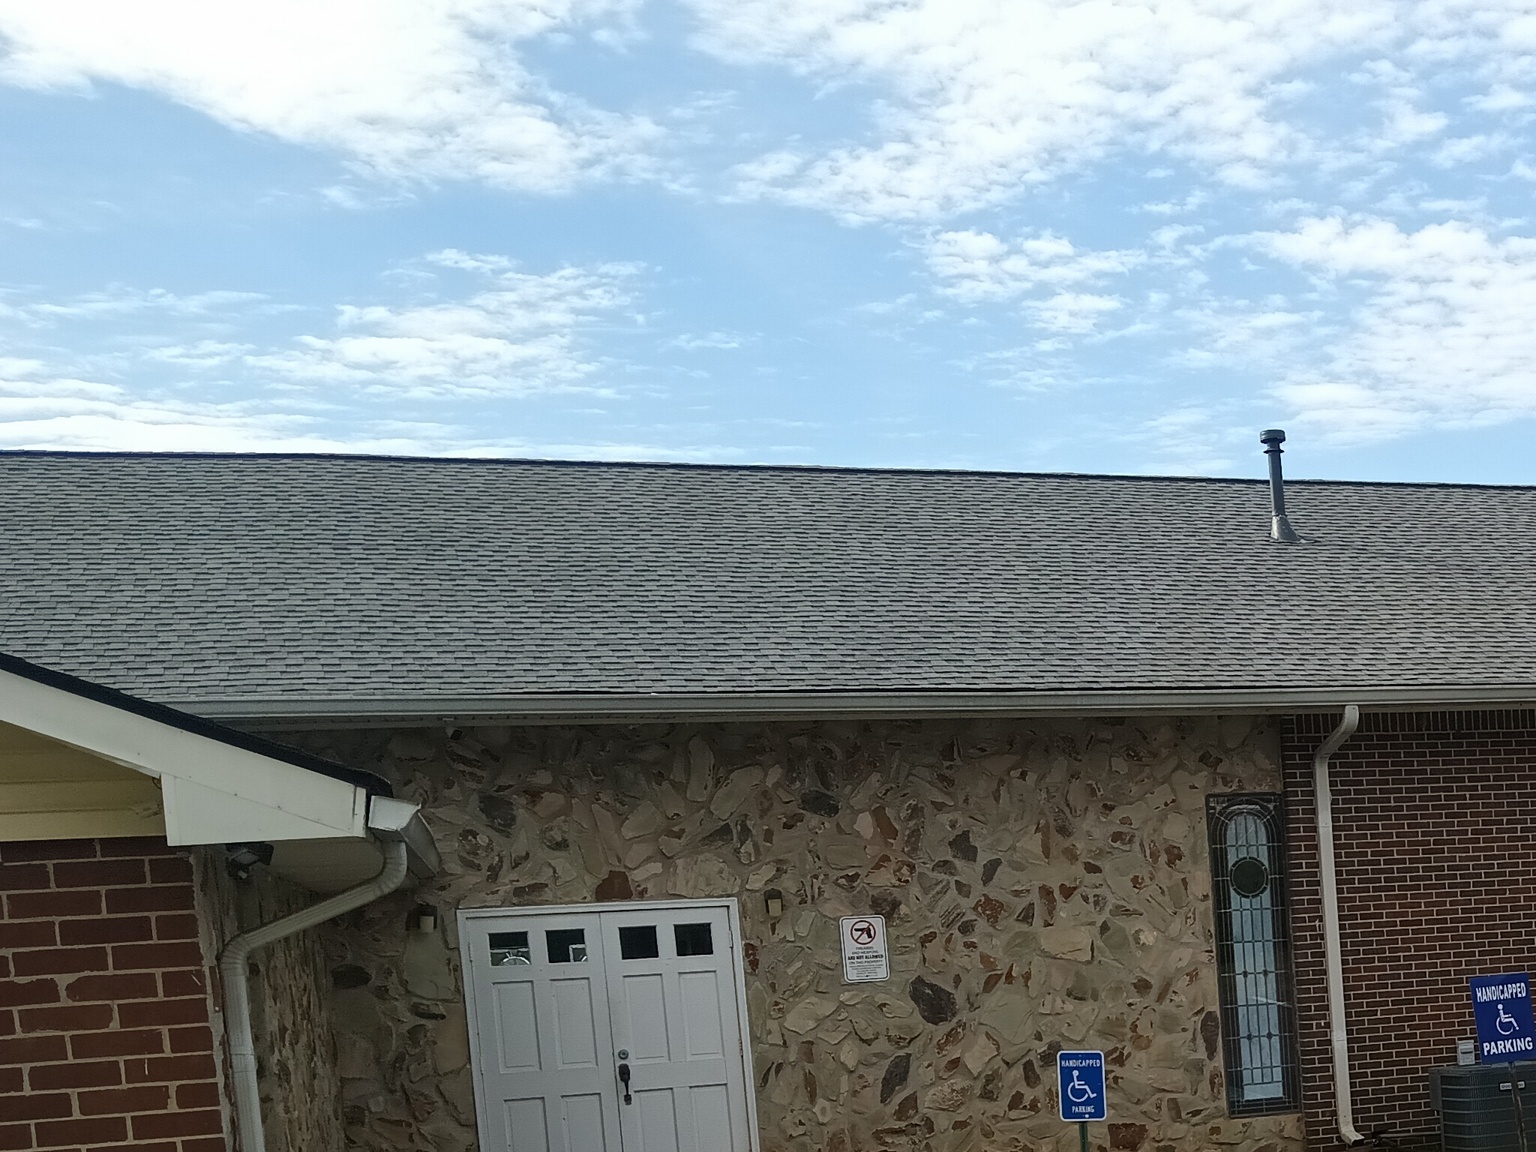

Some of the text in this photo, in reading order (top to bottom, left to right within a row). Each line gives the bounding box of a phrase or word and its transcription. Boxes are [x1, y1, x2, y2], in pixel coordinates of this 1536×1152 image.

[1476, 982, 1527, 1003] HANDICAPPED
[1483, 1037, 1534, 1056] PARKING
[1061, 1059, 1101, 1068] HANDICAPPED
[1071, 1105, 1096, 1114] PARKING
